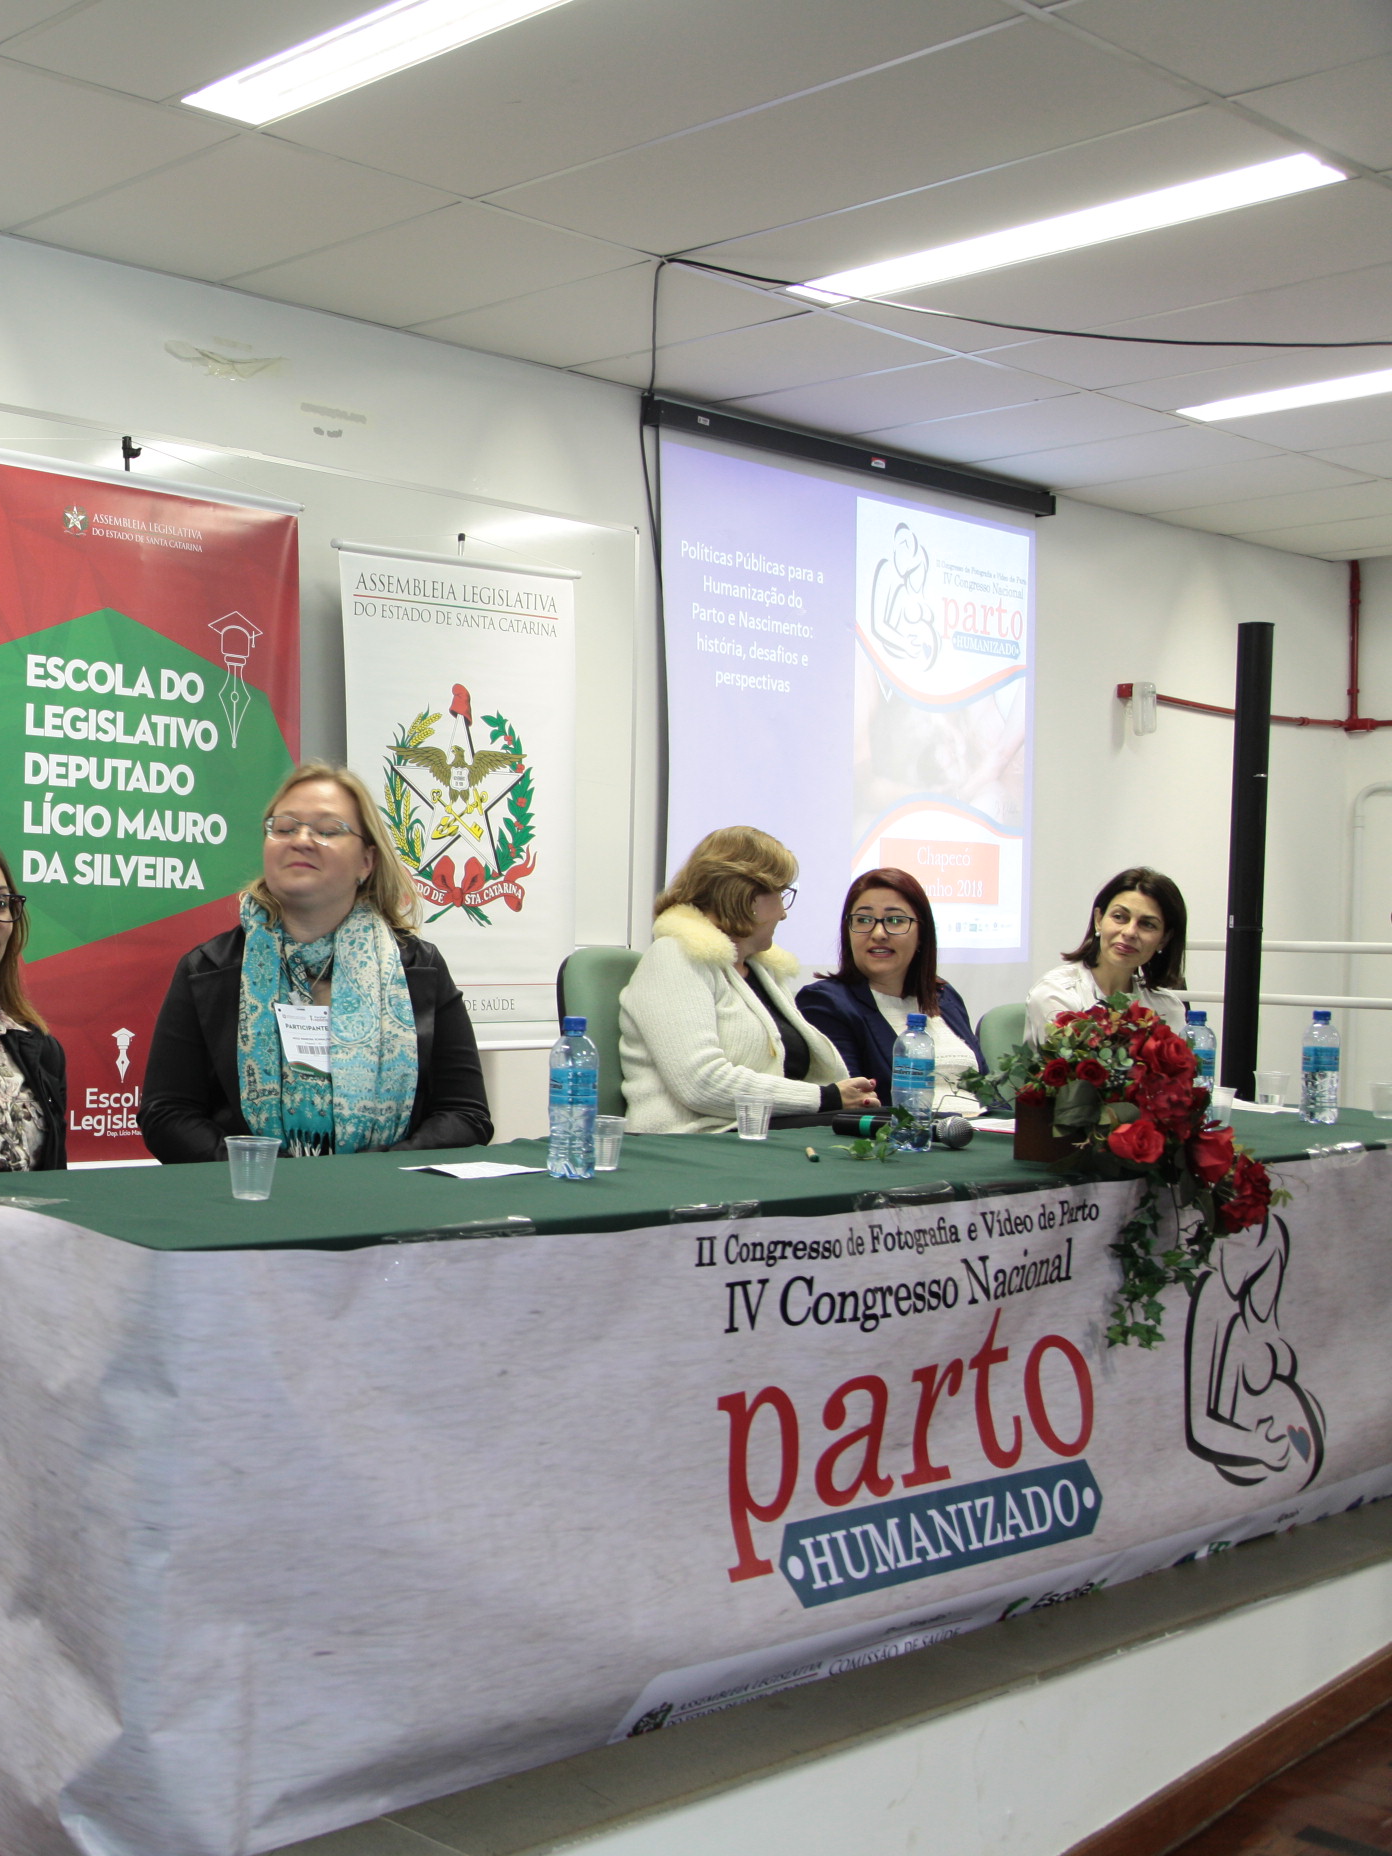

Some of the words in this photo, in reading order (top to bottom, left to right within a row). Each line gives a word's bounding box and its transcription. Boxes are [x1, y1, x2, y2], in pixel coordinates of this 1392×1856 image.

[92, 528, 104, 536] DO
[106, 530, 133, 541] ESTADO
[136, 535, 144, 543] DE
[146, 536, 168, 547] SANTA
[169, 540, 203, 552] CATARINA
[93, 514, 147, 531] ASSEMBLEIA
[149, 522, 202, 540] LEGISLATIVA
[681, 540, 733, 567] Políticas
[736, 550, 785, 577] Públicas
[788, 565, 814, 583] para
[817, 571, 824, 584] a
[355, 572, 457, 601] ASSEMBLEIA
[463, 584, 557, 613] LEGISLATIVA
[703, 575, 785, 606] Humanização
[788, 589, 802, 608] do
[954, 574, 990, 592] Congresso
[992, 582, 1024, 599] Nacional
[354, 601, 376, 617] DO
[381, 604, 432, 623] ESTADO
[436, 610, 452, 626] DE
[456, 612, 496, 630] SANTA
[498, 617, 557, 637] CATARINA
[692, 602, 725, 625] Parto
[728, 613, 735, 626] e
[739, 608, 813, 638] Nascimento:
[942, 597, 1023, 640] parto
[696, 632, 746, 660] história,
[749, 639, 798, 666] desafios
[802, 653, 808, 667] e
[957, 635, 1016, 656] HUMANIZADO
[26, 654, 155, 698] ESCOLA
[160, 668, 204, 704] DO
[715, 669, 790, 692] perspectivas
[26, 702, 218, 752] LEGISLATIVO
[24, 752, 194, 796] DEPUTADO
[24, 792, 111, 838] LÍCIO
[117, 806, 228, 844] MAURO
[22, 850, 68, 884] DA
[73, 852, 204, 890] SILVEIRA
[917, 847, 971, 872] Chapecó
[431, 891, 444, 904] DE
[464, 894, 484, 904] STA.
[484, 882, 522, 900] CATARINA
[923, 878, 952, 897] unho
[957, 880, 984, 898] 2018
[481, 996, 515, 1011] SAÚDE
[285, 1023, 329, 1032] PARTICIPANTE
[86, 1086, 142, 1108] Escol
[70, 1108, 138, 1137] Legisla
[694, 1236, 716, 1267] II
[724, 1233, 842, 1267] Congresso
[846, 1227, 864, 1255] de
[869, 1217, 960, 1255] Fotografia
[968, 1224, 978, 1240] e
[982, 1210, 1034, 1238] Vídeo
[1038, 1202, 1056, 1228] de
[1060, 1200, 1100, 1225] Parto
[724, 1278, 770, 1334] IV
[779, 1274, 958, 1332] Congresso
[961, 1238, 1072, 1306] Nacional
[717, 1307, 1094, 1583] parto
[800, 1479, 1078, 1590] HUMANIZADO
